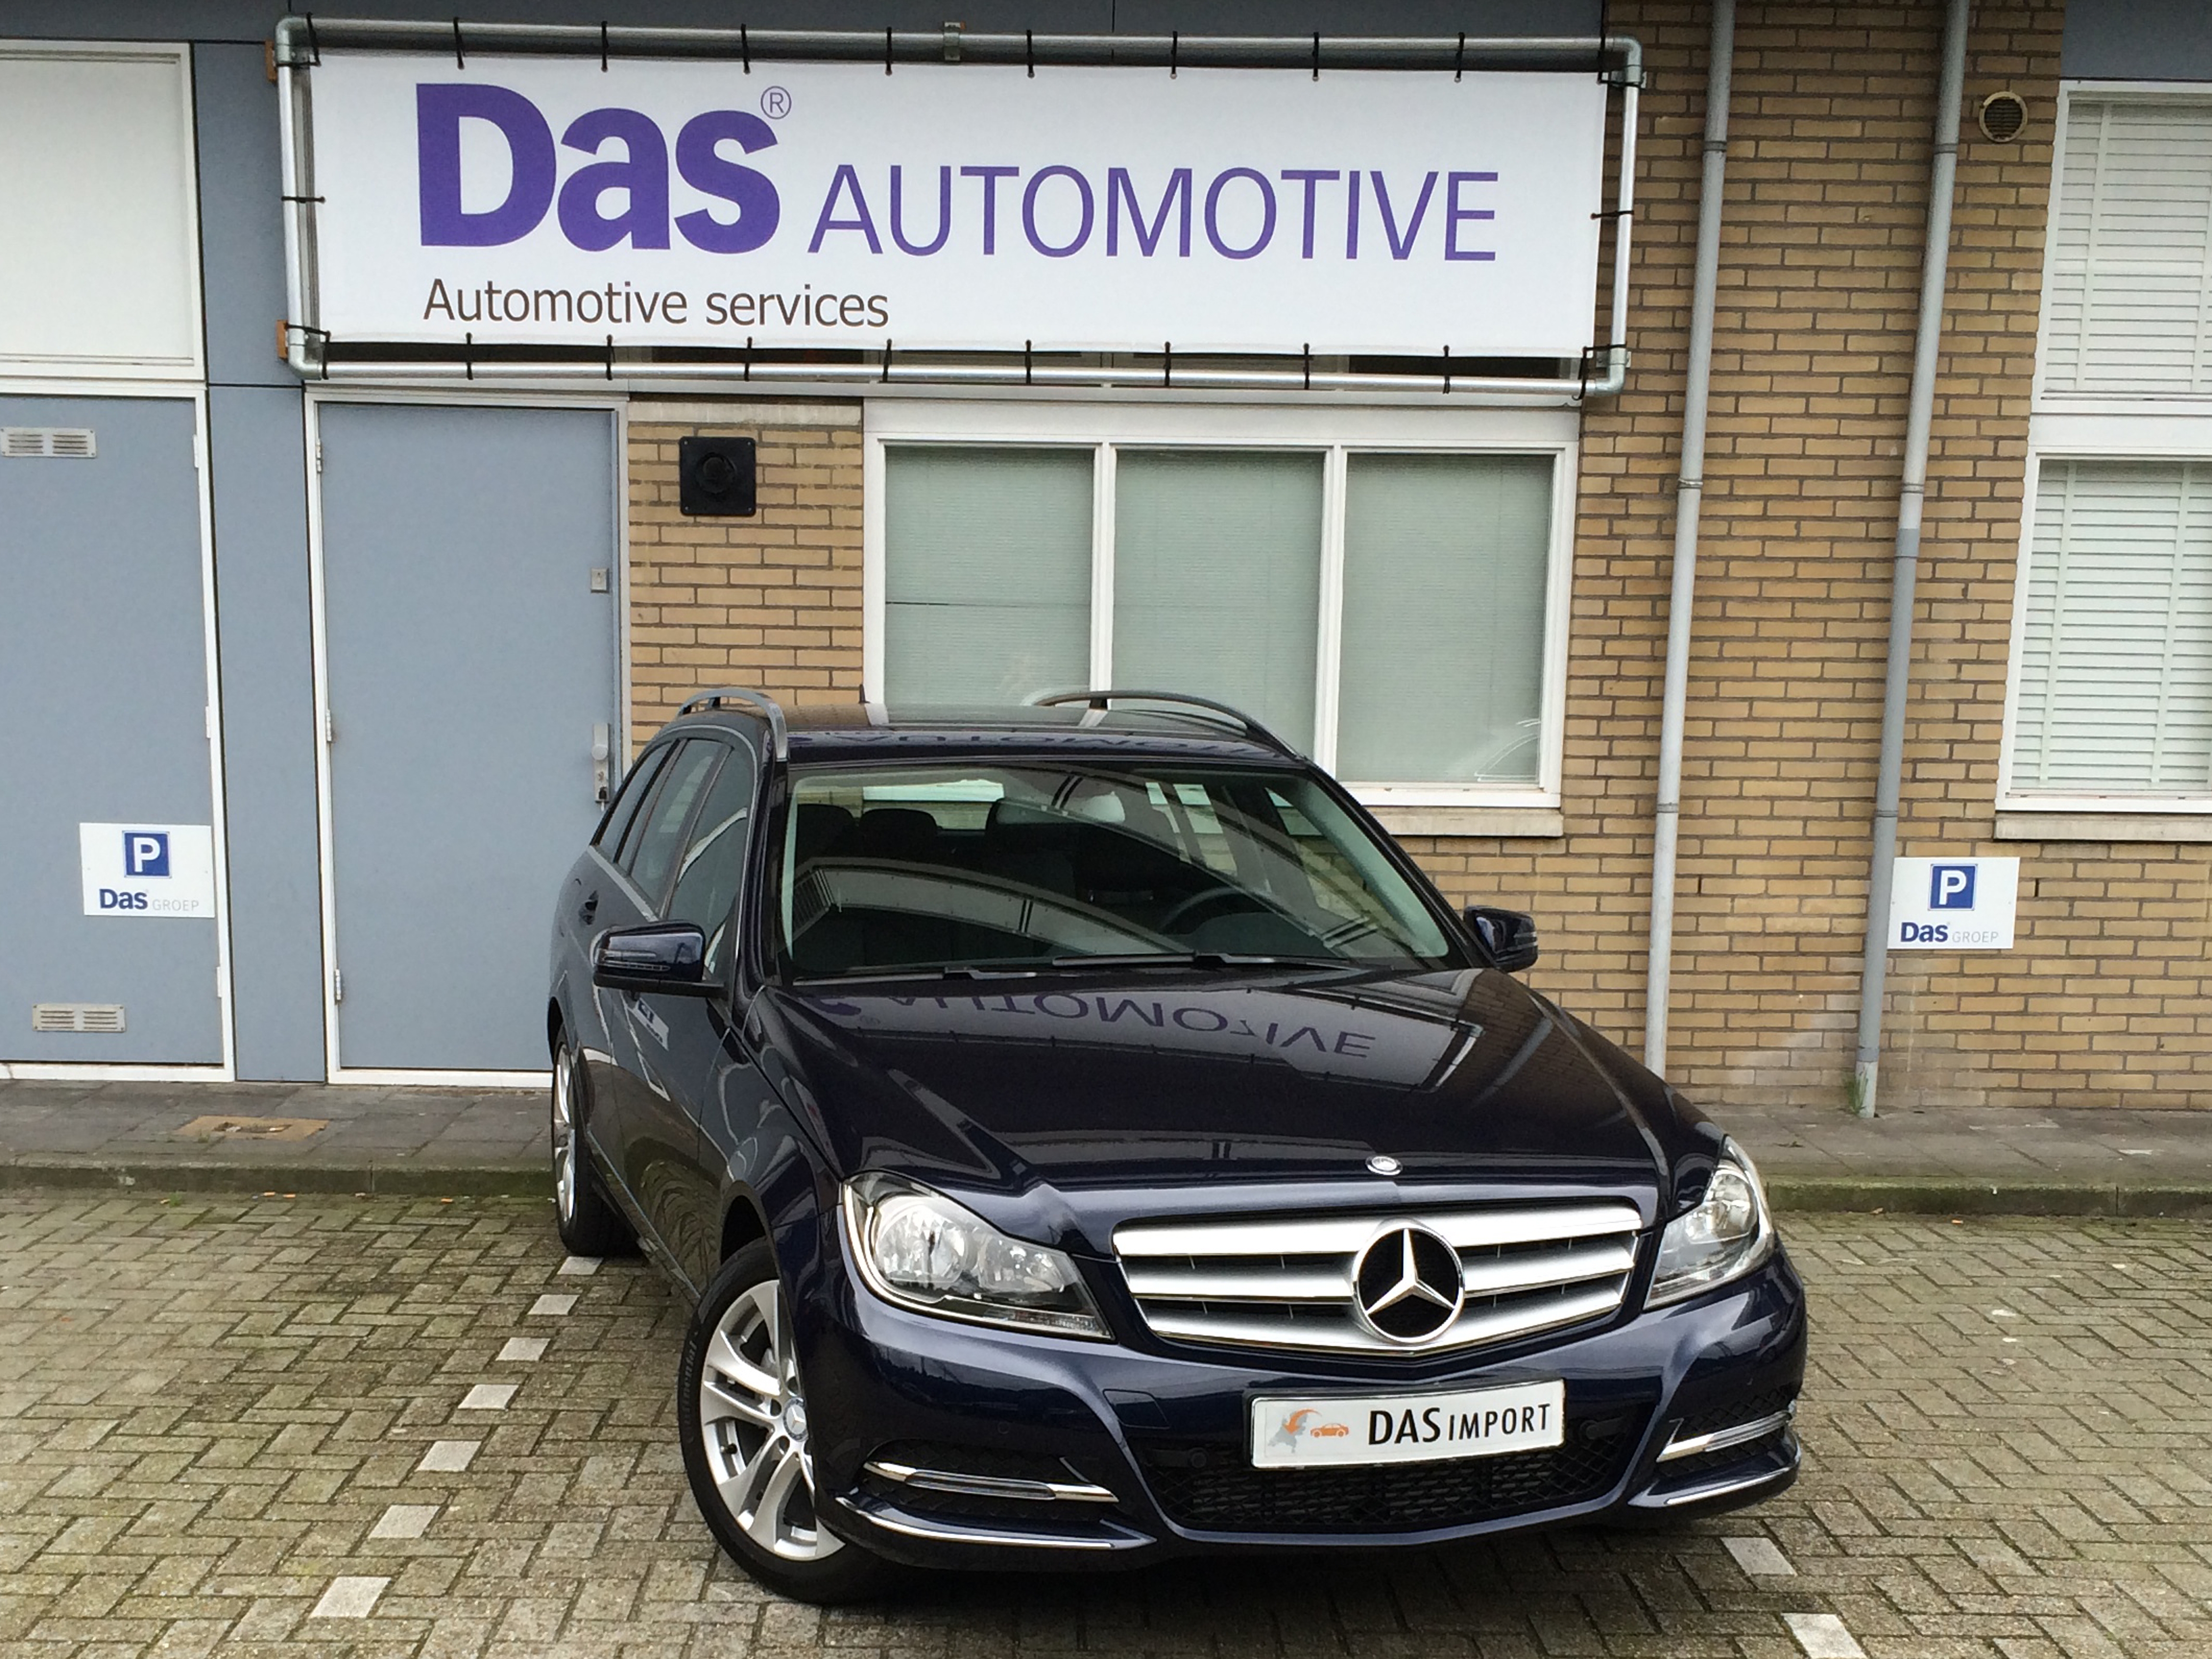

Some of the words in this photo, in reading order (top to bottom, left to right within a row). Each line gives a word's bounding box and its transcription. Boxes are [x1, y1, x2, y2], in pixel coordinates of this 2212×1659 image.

[807, 164, 1498, 261] AUTOMOTIVE
[423, 278, 687, 324] Automotive
[706, 284, 889, 327] services
[133, 837, 161, 873] P
[99, 889, 148, 910] Das
[152, 899, 199, 911] GROEP
[1939, 870, 1967, 905] P
[1900, 922, 1948, 942] Das
[1952, 931, 1999, 943] GROEP
[1369, 1407, 1441, 1445] DAS
[1448, 1403, 1551, 1441] IMPORT
